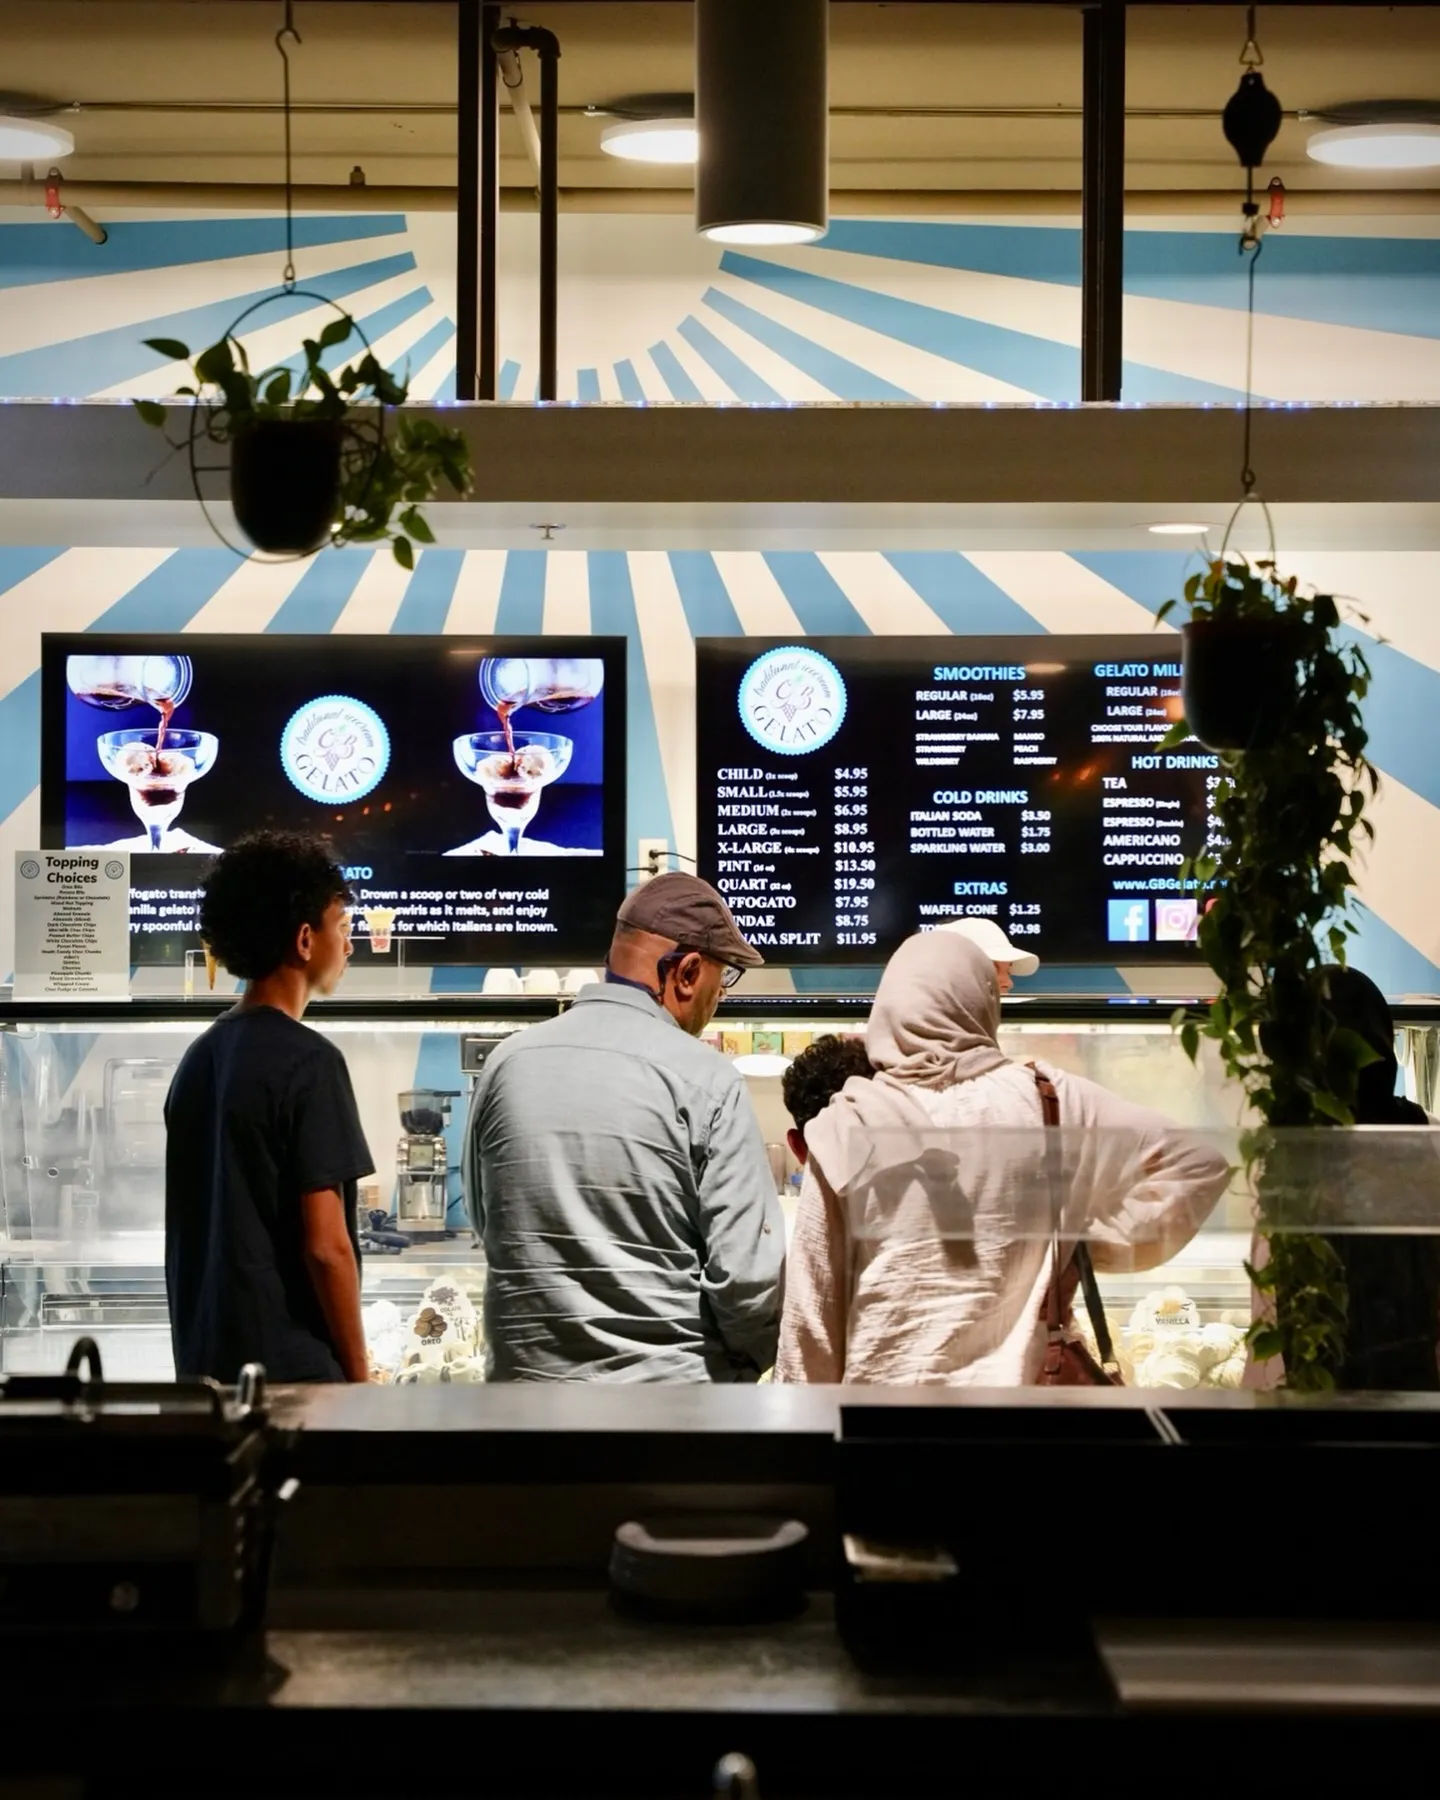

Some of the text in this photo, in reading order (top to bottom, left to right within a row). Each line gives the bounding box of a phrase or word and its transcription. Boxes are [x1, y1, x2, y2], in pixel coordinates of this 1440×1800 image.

[934, 667, 1026, 681] SMOOTHIES
[1094, 664, 1148, 677] GELATO
[916, 691, 967, 701] REGULAR
[1013, 690, 1044, 701] $5.95
[1106, 687, 1158, 696] REGULAR
[916, 710, 952, 720] LARGE
[1013, 709, 1044, 721] $7.95
[1107, 706, 1143, 716] LARGE
[754, 705, 832, 744] GELATO
[1014, 745, 1038, 753] PEACH
[1132, 756, 1218, 768] HOT DRINKS
[296, 754, 375, 792] GELATO
[717, 768, 763, 780] CHILD
[834, 768, 868, 780] $4.95
[1103, 778, 1127, 789] TEA
[717, 786, 768, 798] SMALL
[834, 786, 868, 798] $5.95
[933, 791, 1028, 804] COLD DRINKS
[1103, 798, 1154, 808] ESPRESSO
[717, 805, 779, 817] MEDIUM
[834, 804, 868, 817] $6.95
[910, 810, 1051, 822] ITALIAN SODA $3.50
[718, 824, 768, 835] LARGE
[834, 823, 868, 835] $8.95
[1103, 818, 1154, 828] ESPRESSO
[910, 827, 1051, 838] BOTTLED WATER $1.75
[1103, 835, 1181, 847] AMERICANO
[717, 842, 782, 854] X-LARGE
[834, 841, 875, 854] $10.95
[910, 843, 1050, 854] SPARKLING WATER $3.00
[46, 856, 99, 869] Topping
[1103, 854, 1184, 865] CAPPUCCINO
[718, 860, 752, 872] PINT
[835, 860, 876, 872] $13.50
[47, 872, 97, 883] Choices
[717, 879, 768, 892] QUART
[834, 878, 875, 891] $19.50
[954, 882, 1008, 895] EXTRAS
[360, 889, 549, 902] Drown a scoop or two of very cold
[836, 896, 869, 909] $7.95
[159, 904, 195, 917] gelato
[430, 908, 442, 916] as
[445, 905, 453, 916] it
[456, 905, 490, 917] melts,
[492, 905, 513, 916] and
[516, 905, 547, 918] enjoy
[919, 904, 1041, 916] WAFFLE CONE $1.25
[143, 920, 192, 933] spoonful
[398, 921, 414, 932] for
[416, 921, 450, 932] which
[453, 922, 492, 932] Italians
[495, 924, 513, 932] are
[516, 921, 557, 932] known.
[836, 915, 869, 927] $8.75
[1009, 924, 1041, 936] $0.98
[780, 933, 821, 945] SPLIT
[837, 932, 877, 945] $11.95
